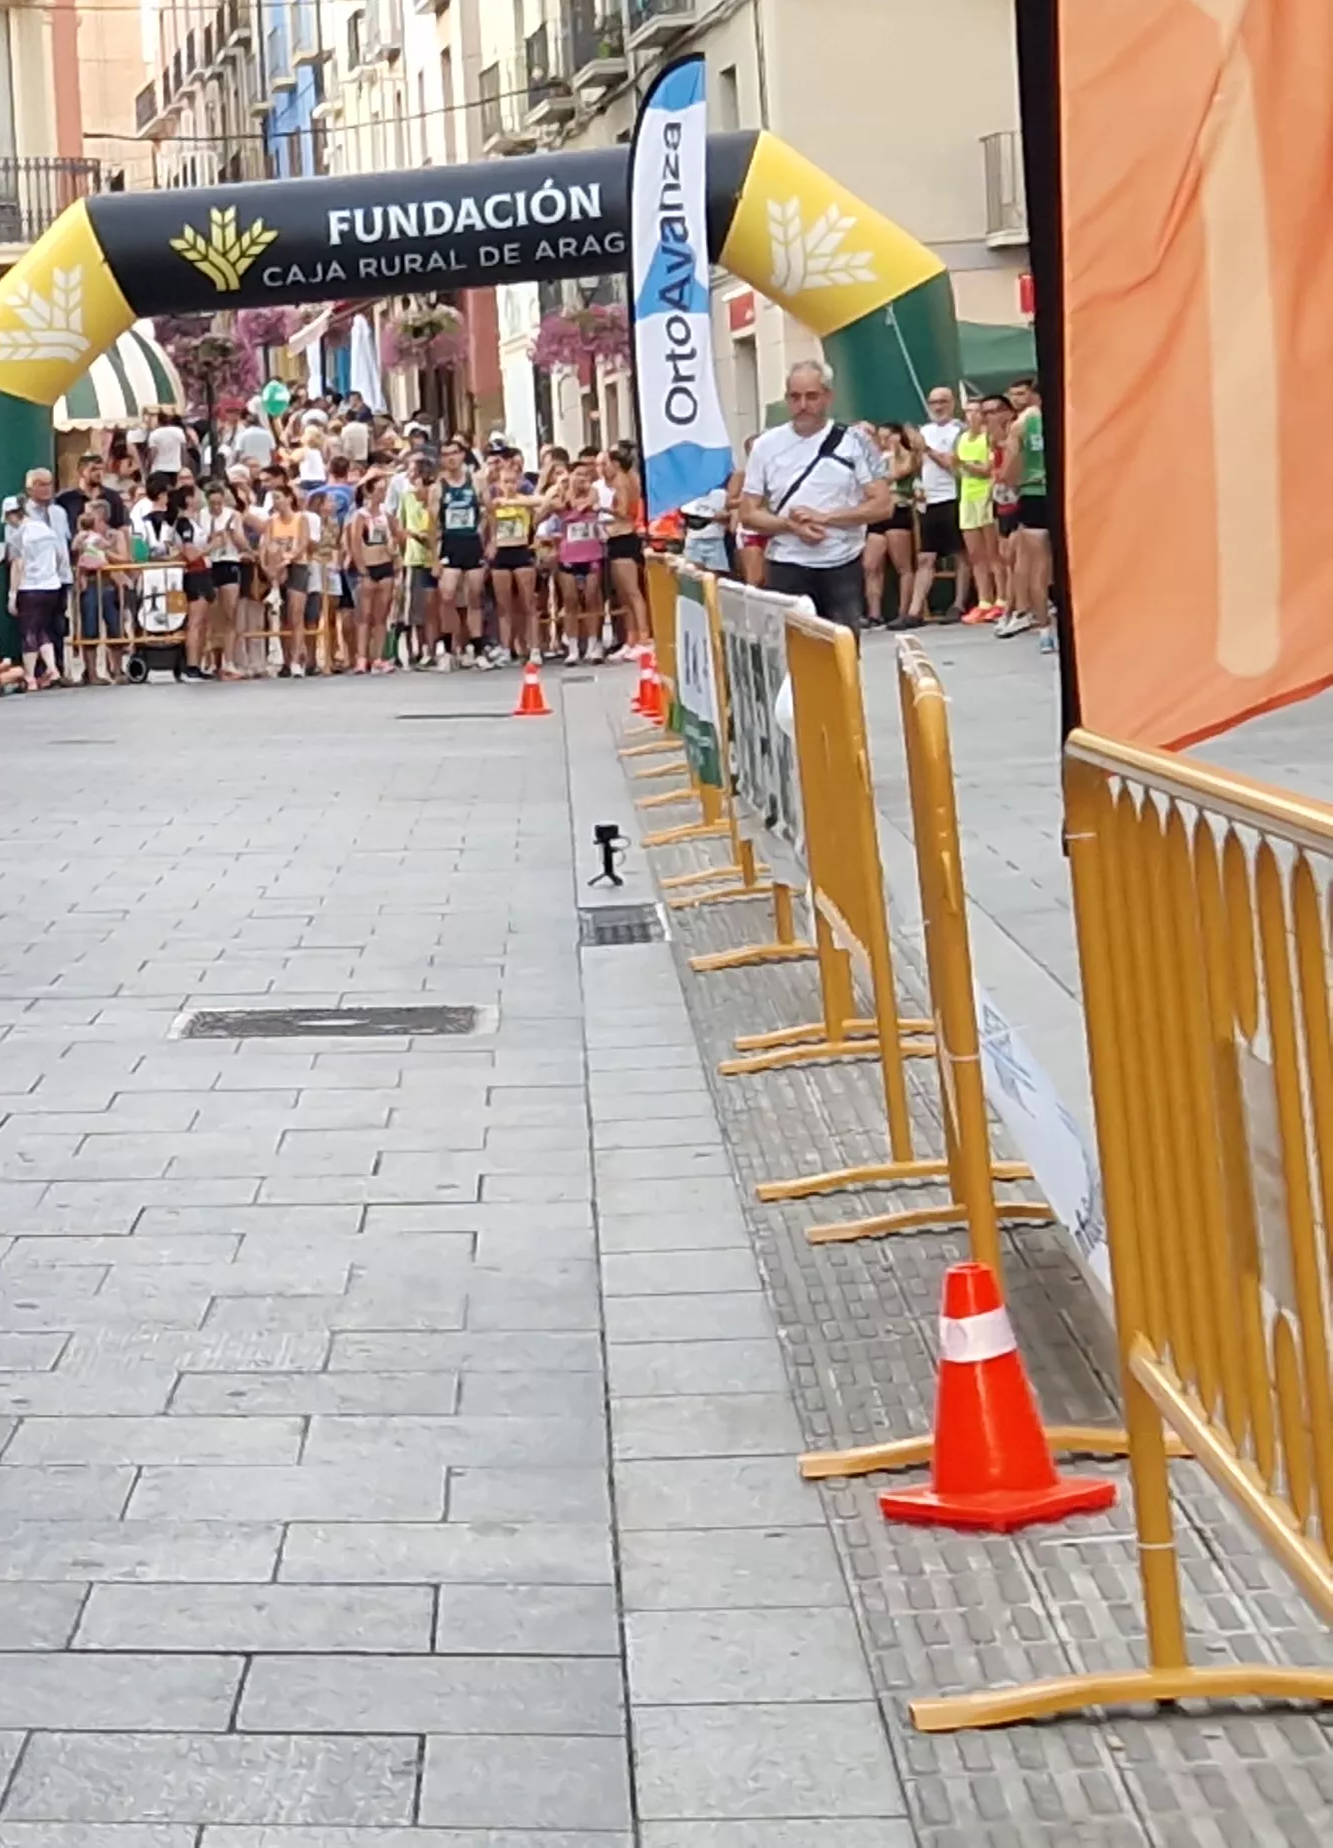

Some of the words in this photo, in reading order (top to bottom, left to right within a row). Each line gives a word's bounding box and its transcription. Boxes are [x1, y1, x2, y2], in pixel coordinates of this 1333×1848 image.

[327, 177, 602, 246] FUNDACIÓN
[262, 259, 347, 288] CAJA
[358, 249, 467, 280] RURAL
[479, 243, 522, 268] DE
[658, 121, 699, 426] OrtoAvanza
